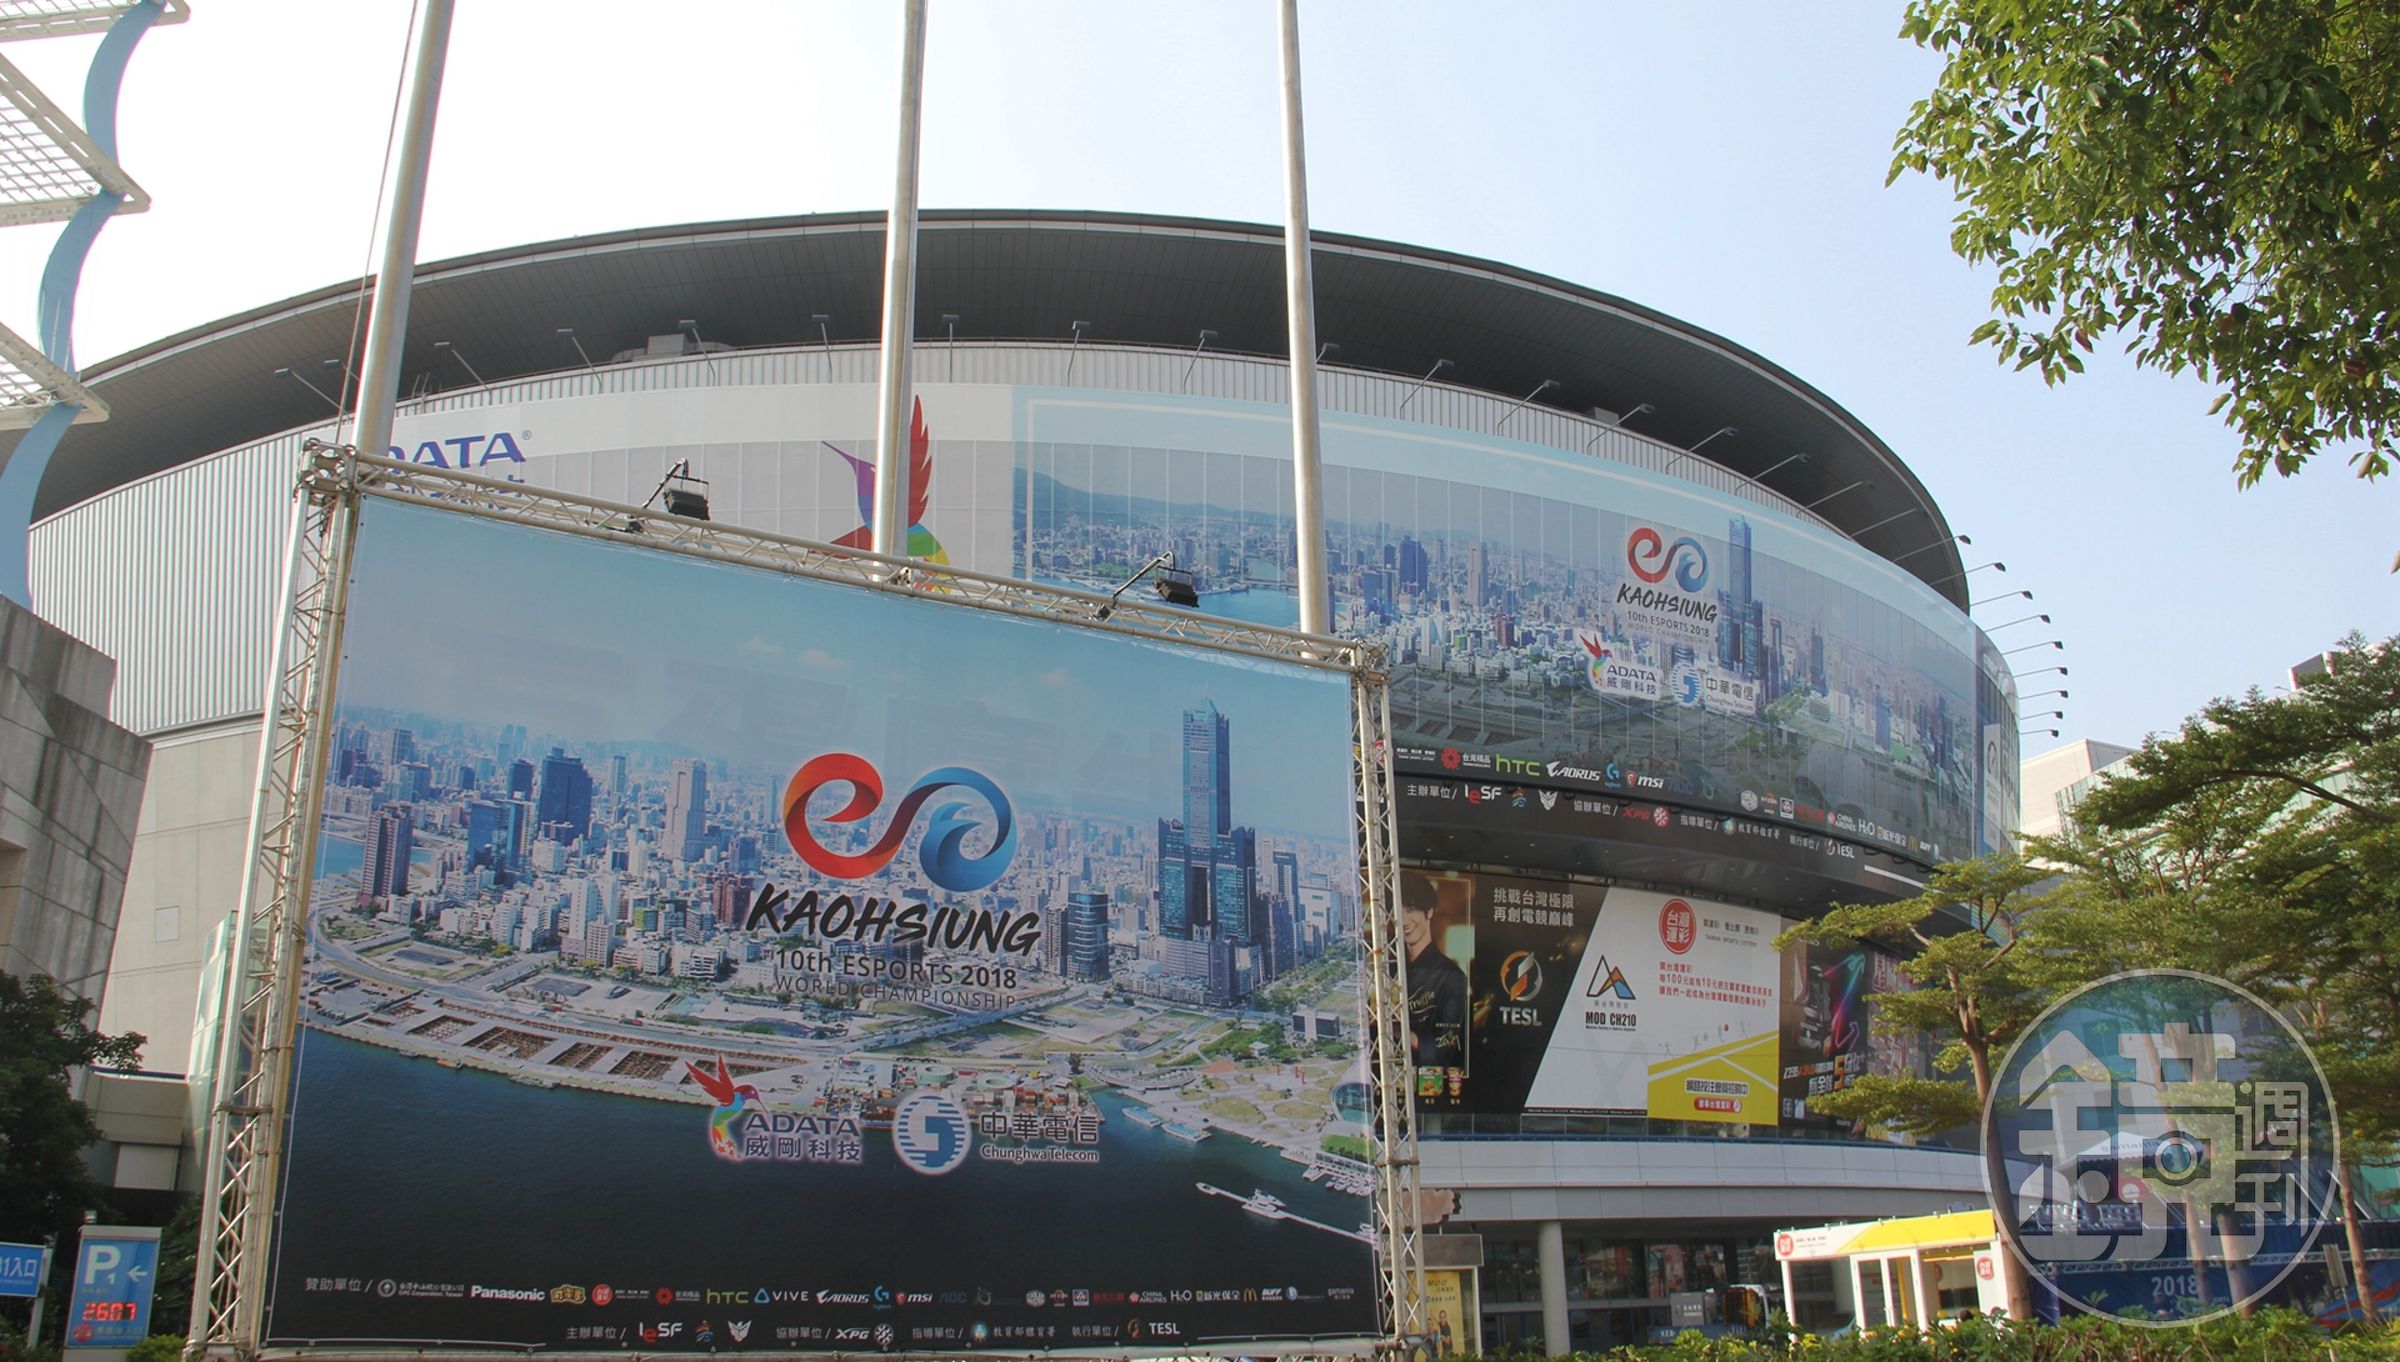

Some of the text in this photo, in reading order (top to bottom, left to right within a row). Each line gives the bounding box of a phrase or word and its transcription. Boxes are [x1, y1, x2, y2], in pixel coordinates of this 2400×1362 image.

[1617, 583, 1718, 624] KAOHSIUNG
[1627, 611, 1710, 638] 10th ESPORTS 2018
[1607, 664, 1656, 682] ADATA
[1706, 677, 1754, 702] 中華電信
[1496, 754, 1540, 777] htc
[1637, 775, 1665, 790] msi
[1494, 887, 1575, 909] 挑戰台灣極限
[745, 883, 1042, 957] KAOHSIUNG
[1667, 911, 1689, 927] 台灣
[775, 950, 1017, 989] 10th ESPORTS 2018
[775, 974, 1016, 1009] WORLD CHAMPIONSHIP
[1500, 1006, 1542, 1027] TESL
[1585, 1011, 1637, 1027] MOD CH210
[745, 1113, 861, 1137] ADATA
[980, 1113, 1099, 1142] 中華電信
[744, 1137, 861, 1161] 威剛科技
[981, 1145, 1099, 1162] Chunghwa Telecom
[471, 1284, 546, 1301] Panasonic
[706, 1288, 749, 1304] htc
[772, 1291, 808, 1301] VIVE
[2151, 1274, 2198, 1297] 2018
[907, 1292, 933, 1303] msi
[81, 1302, 137, 1321] 2607
[835, 1327, 871, 1340] XPG
[1149, 1322, 1180, 1336] TESL
